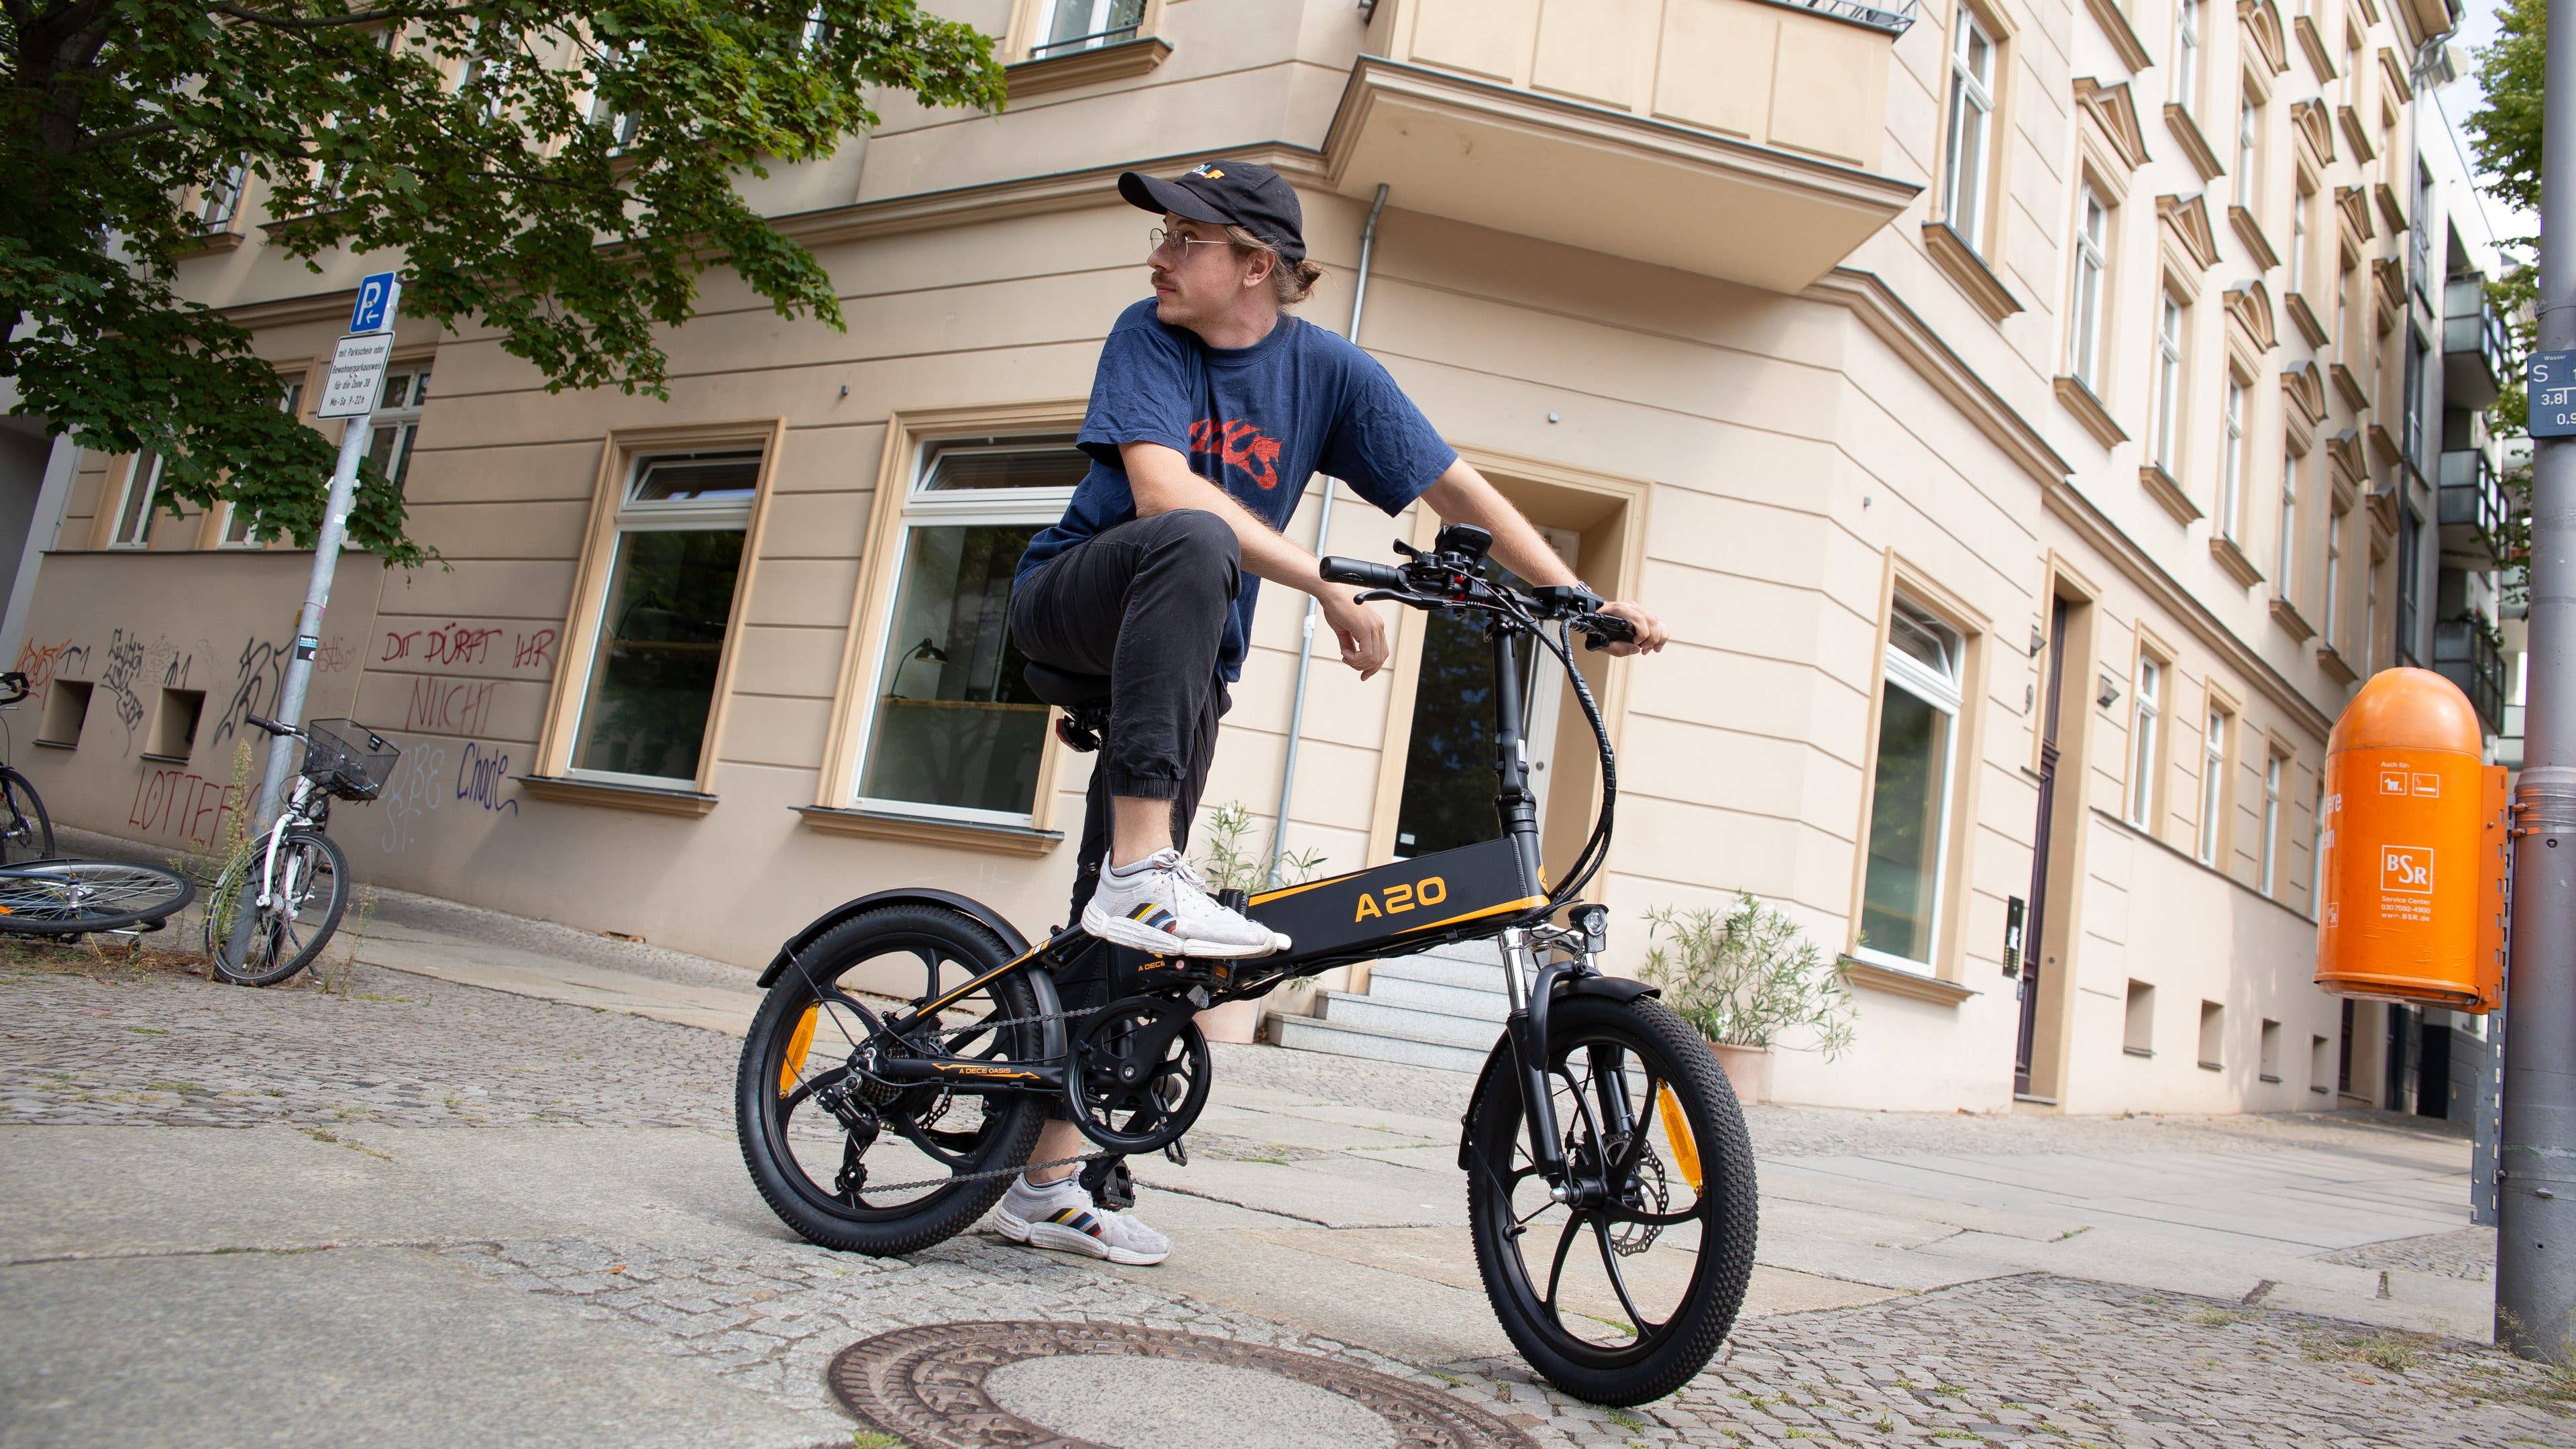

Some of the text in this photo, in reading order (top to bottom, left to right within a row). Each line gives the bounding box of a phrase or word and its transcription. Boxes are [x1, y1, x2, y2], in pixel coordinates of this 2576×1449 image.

[356, 282, 381, 325] P
[338, 345, 385, 358] mit Parkschein oder
[332, 362, 382, 374] Bewohnerparkausweis
[2532, 364, 2548, 383] S
[342, 380, 350, 390] die
[351, 379, 363, 389] Zone
[2387, 853, 2427, 885] BSR
[1354, 875, 1447, 923] A20
[2381, 896, 2432, 906] Service Center
